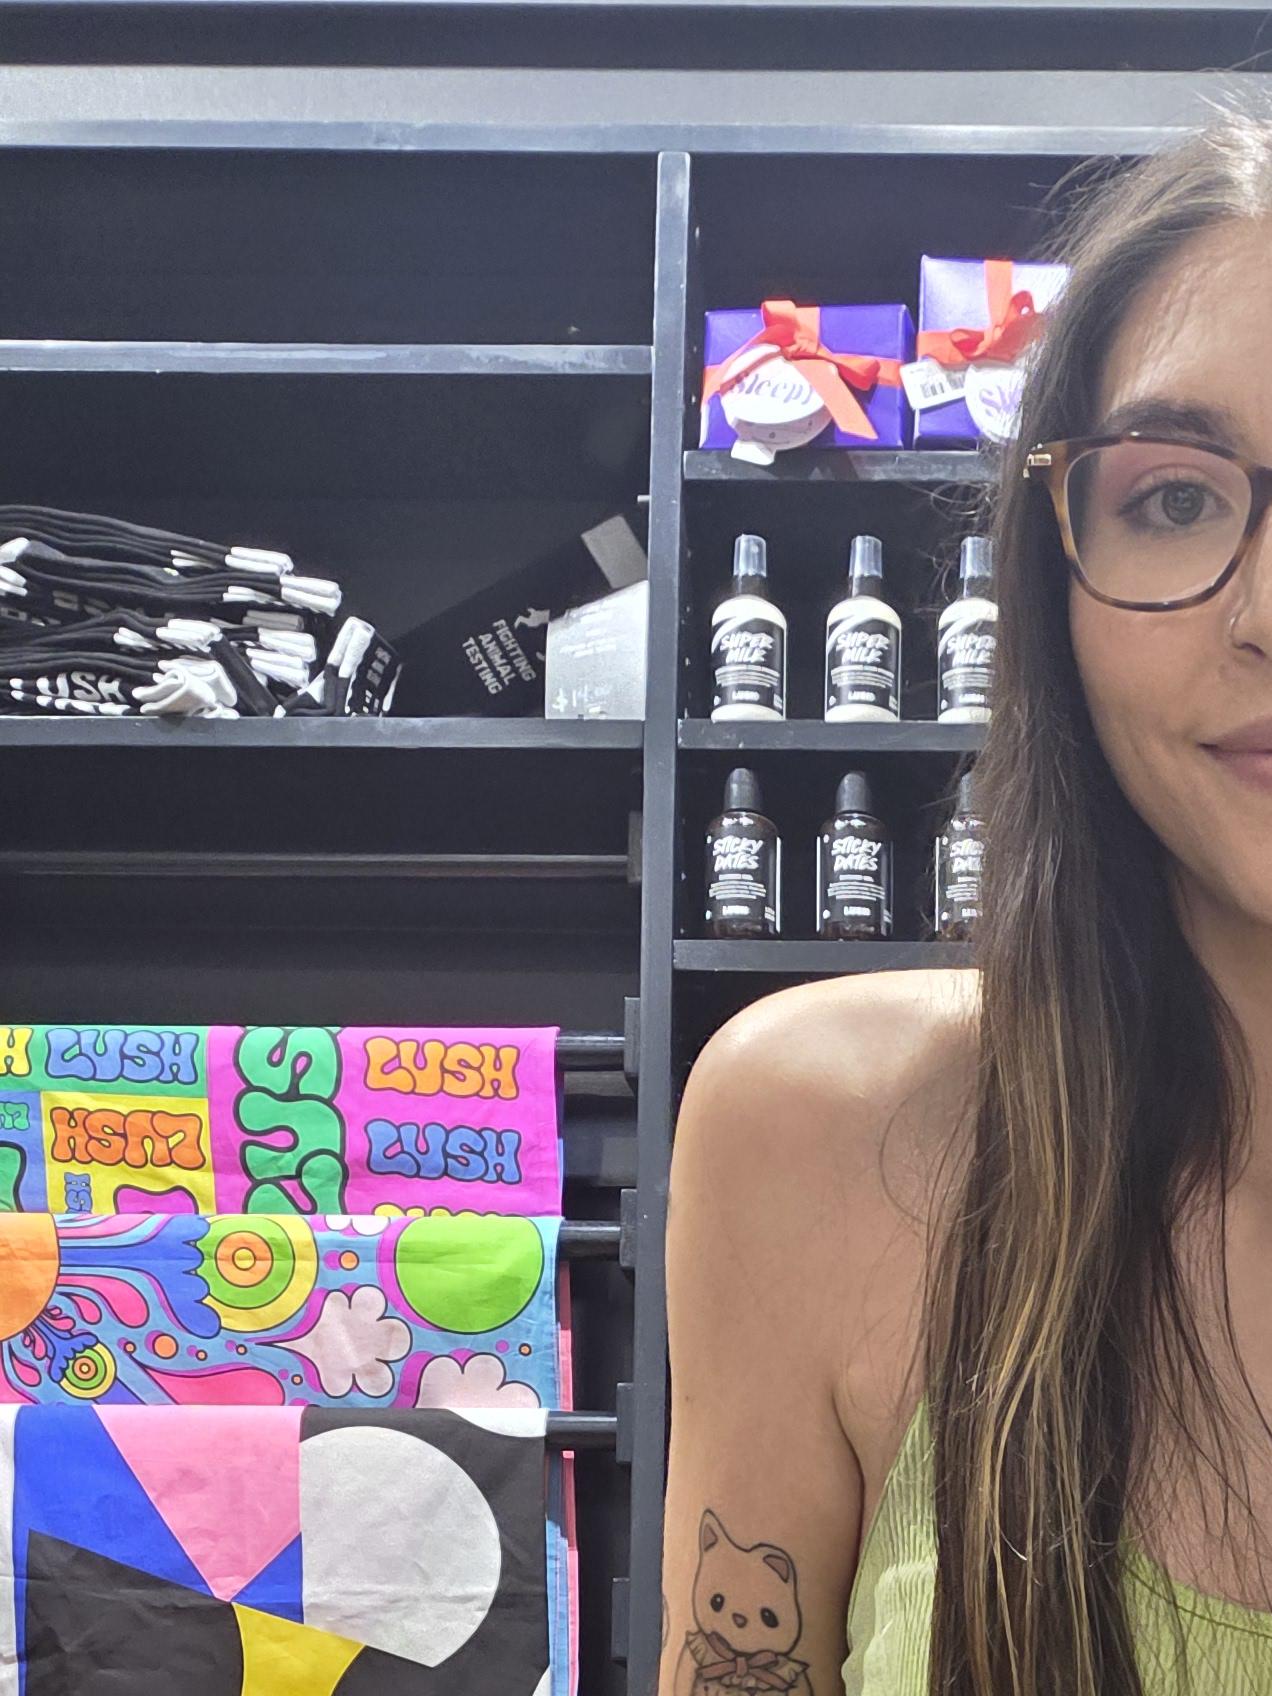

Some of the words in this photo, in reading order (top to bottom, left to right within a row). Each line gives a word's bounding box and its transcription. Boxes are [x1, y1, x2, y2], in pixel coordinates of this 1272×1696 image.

[492, 619, 536, 682] FIGHTING
[720, 631, 774, 651] SUPER
[836, 631, 889, 652] SUPER
[462, 637, 502, 695] TESTING
[478, 633, 516, 686] ANIMAL
[726, 647, 767, 665] MILK
[842, 647, 883, 665] MILK
[713, 835, 763, 856] STICKY
[831, 836, 881, 856] STICKY
[714, 852, 759, 872] DATES
[834, 853, 878, 872] DATES
[45, 1028, 199, 1085] LUSH
[364, 1036, 520, 1100] LUSH
[50, 1107, 206, 1171] LUSH
[365, 1118, 522, 1185] LUSH
